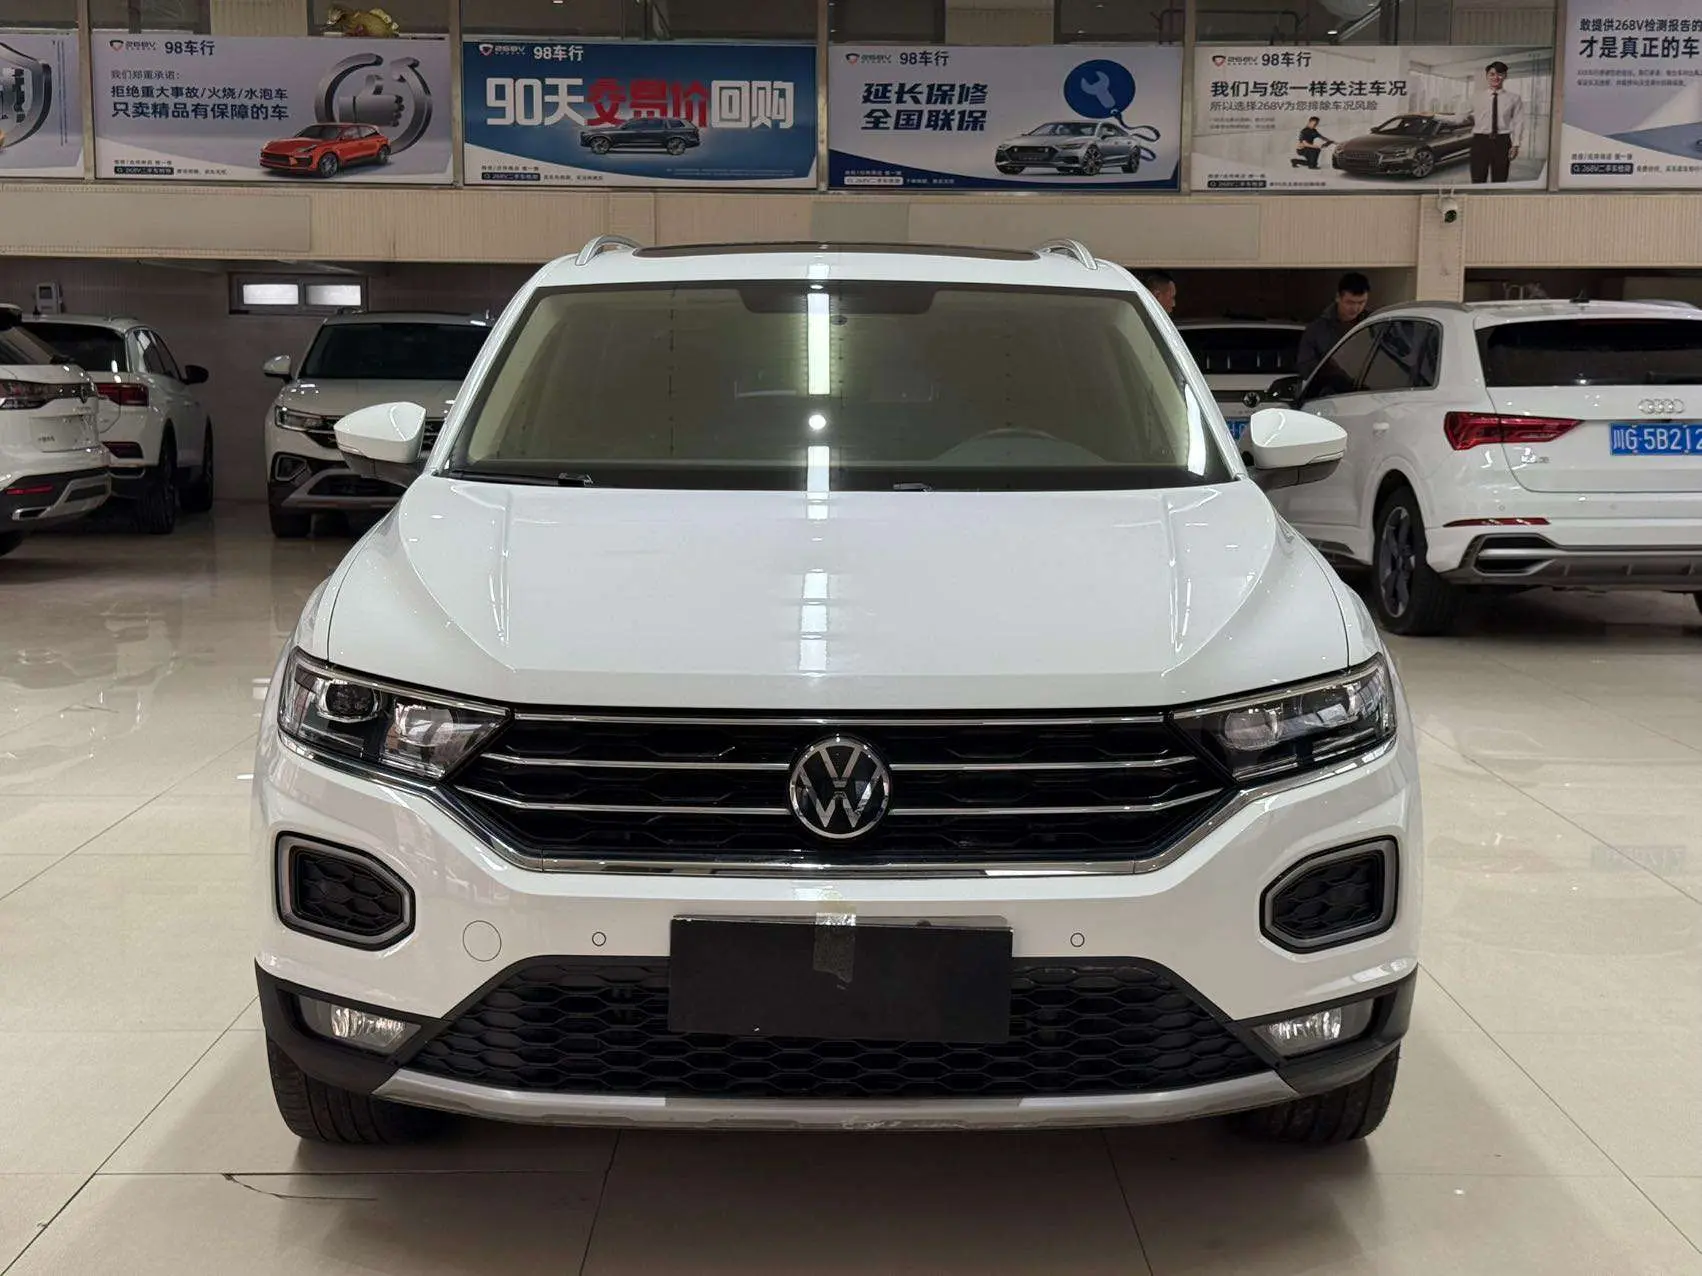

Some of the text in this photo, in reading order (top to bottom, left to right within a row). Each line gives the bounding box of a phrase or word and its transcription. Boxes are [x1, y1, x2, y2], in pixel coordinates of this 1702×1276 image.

[164, 40, 215, 55] 98车行
[533, 45, 584, 61] 98车行
[1579, 36, 1700, 59] 才是真正的车
[900, 50, 949, 66] 98车行
[1261, 52, 1311, 67] 98车行
[111, 85, 288, 100] 拒绝重大事故/火烧/水泡车
[861, 83, 988, 105] 延长保修
[1210, 80, 1408, 97] 我们与您一样关注车况
[112, 101, 290, 121] 只卖精品有保障的车
[486, 77, 795, 129] 90天交易价回购
[861, 108, 988, 131] 全国联保
